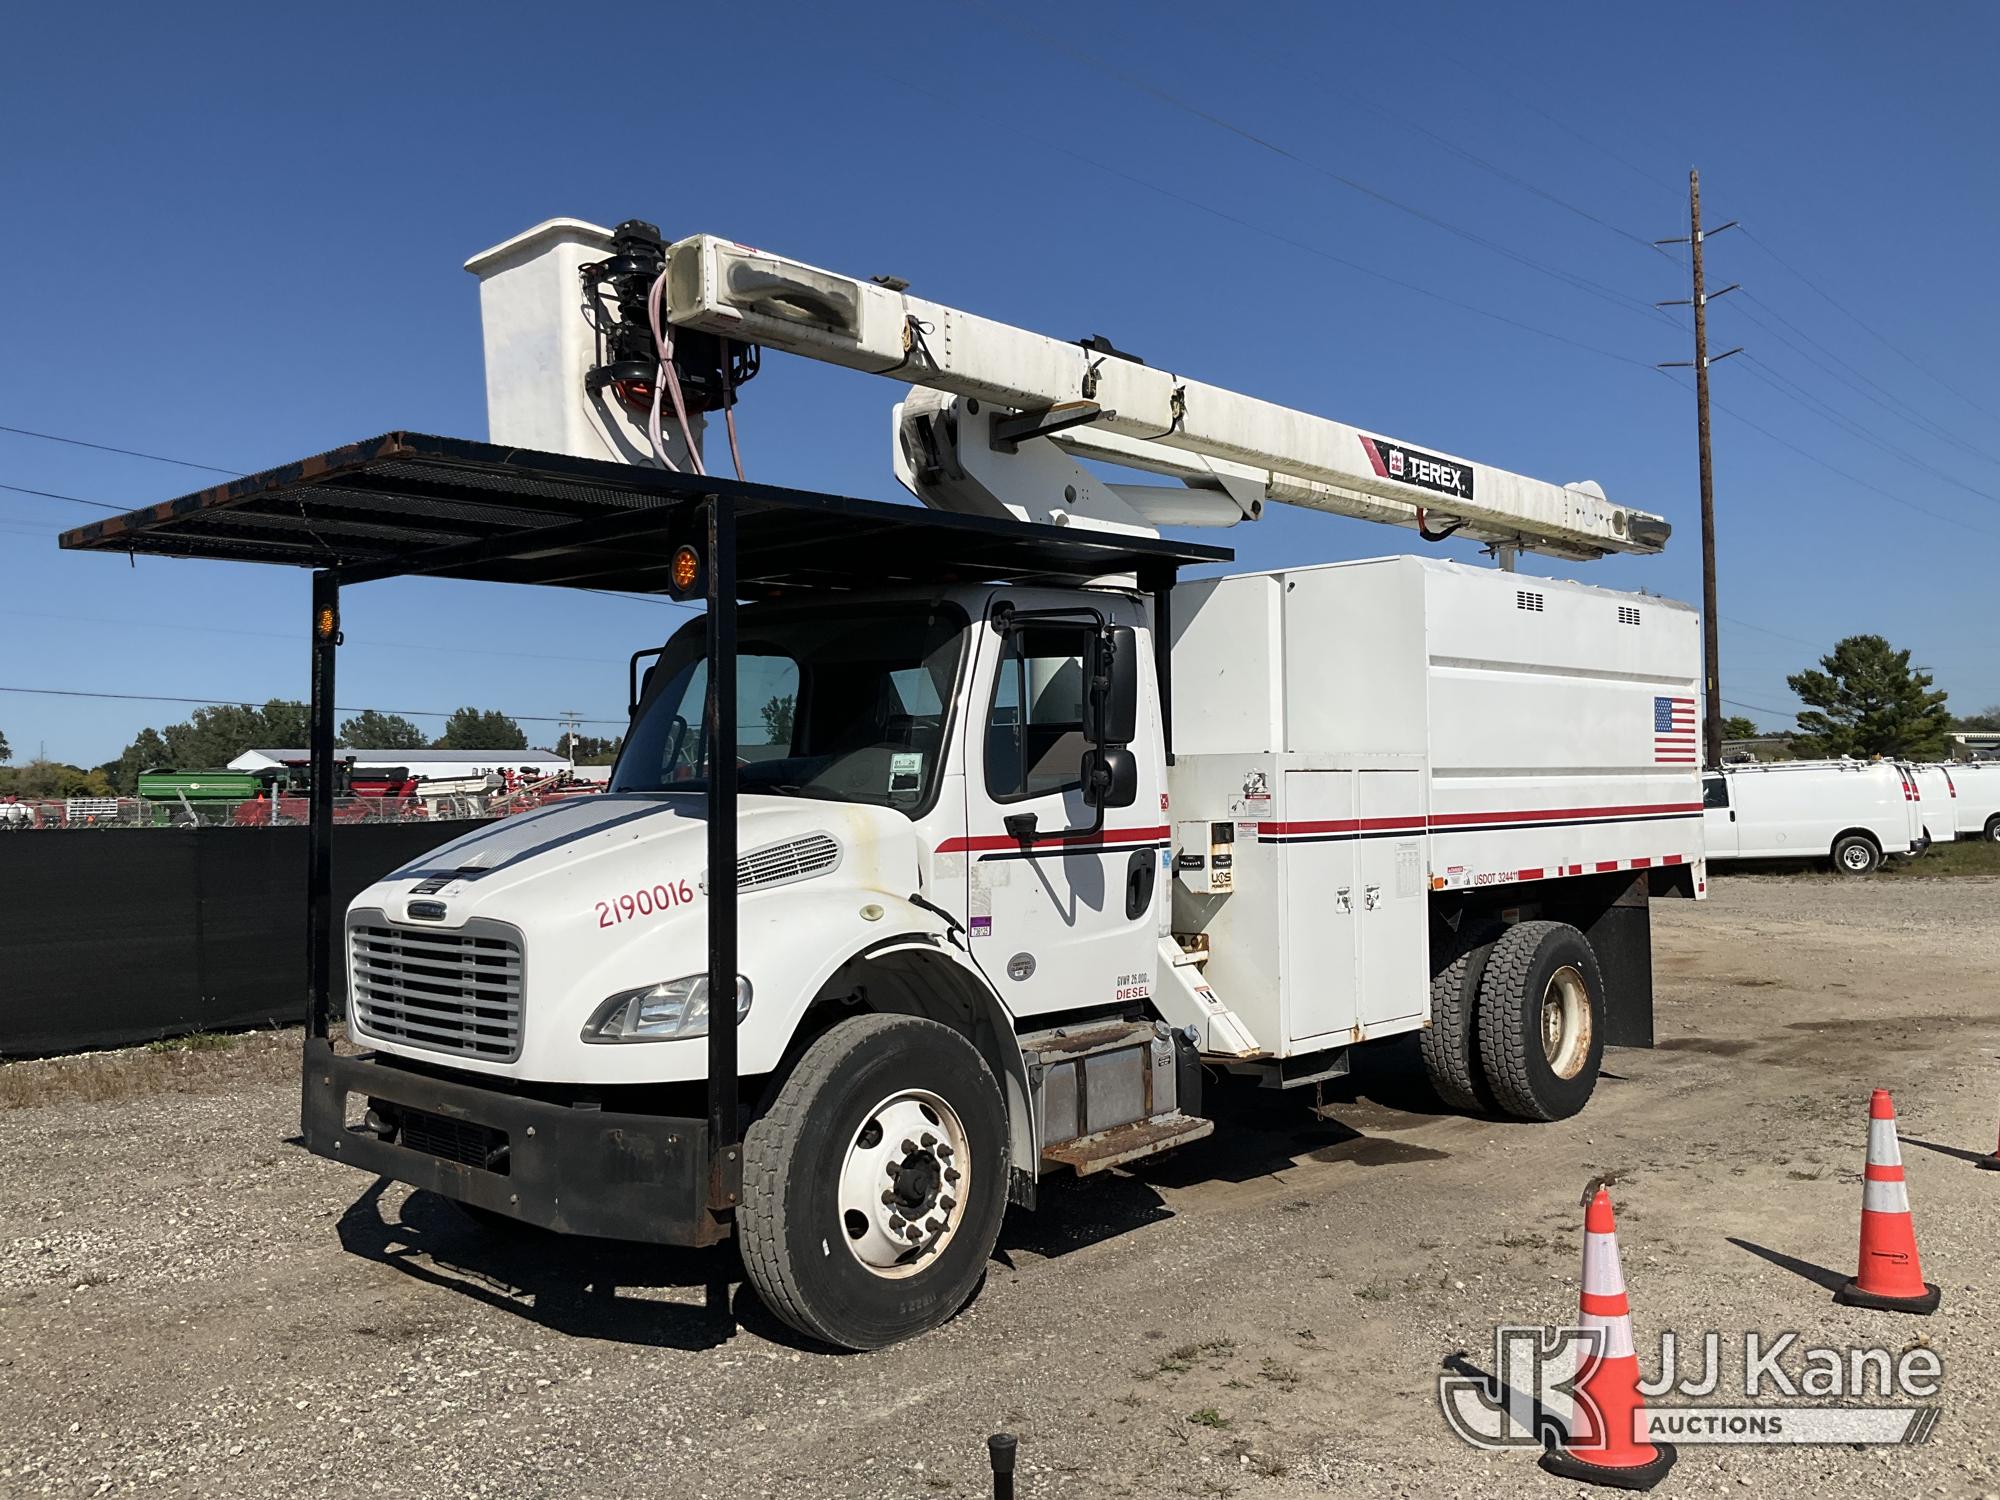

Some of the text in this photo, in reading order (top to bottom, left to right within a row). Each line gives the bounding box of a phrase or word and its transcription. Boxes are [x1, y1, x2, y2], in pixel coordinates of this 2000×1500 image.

[1408, 456, 1462, 490] TEREX
[1473, 873, 1497, 886] USDOT
[595, 878, 694, 928] 2190016
[1116, 986, 1150, 1000] DIESEL
